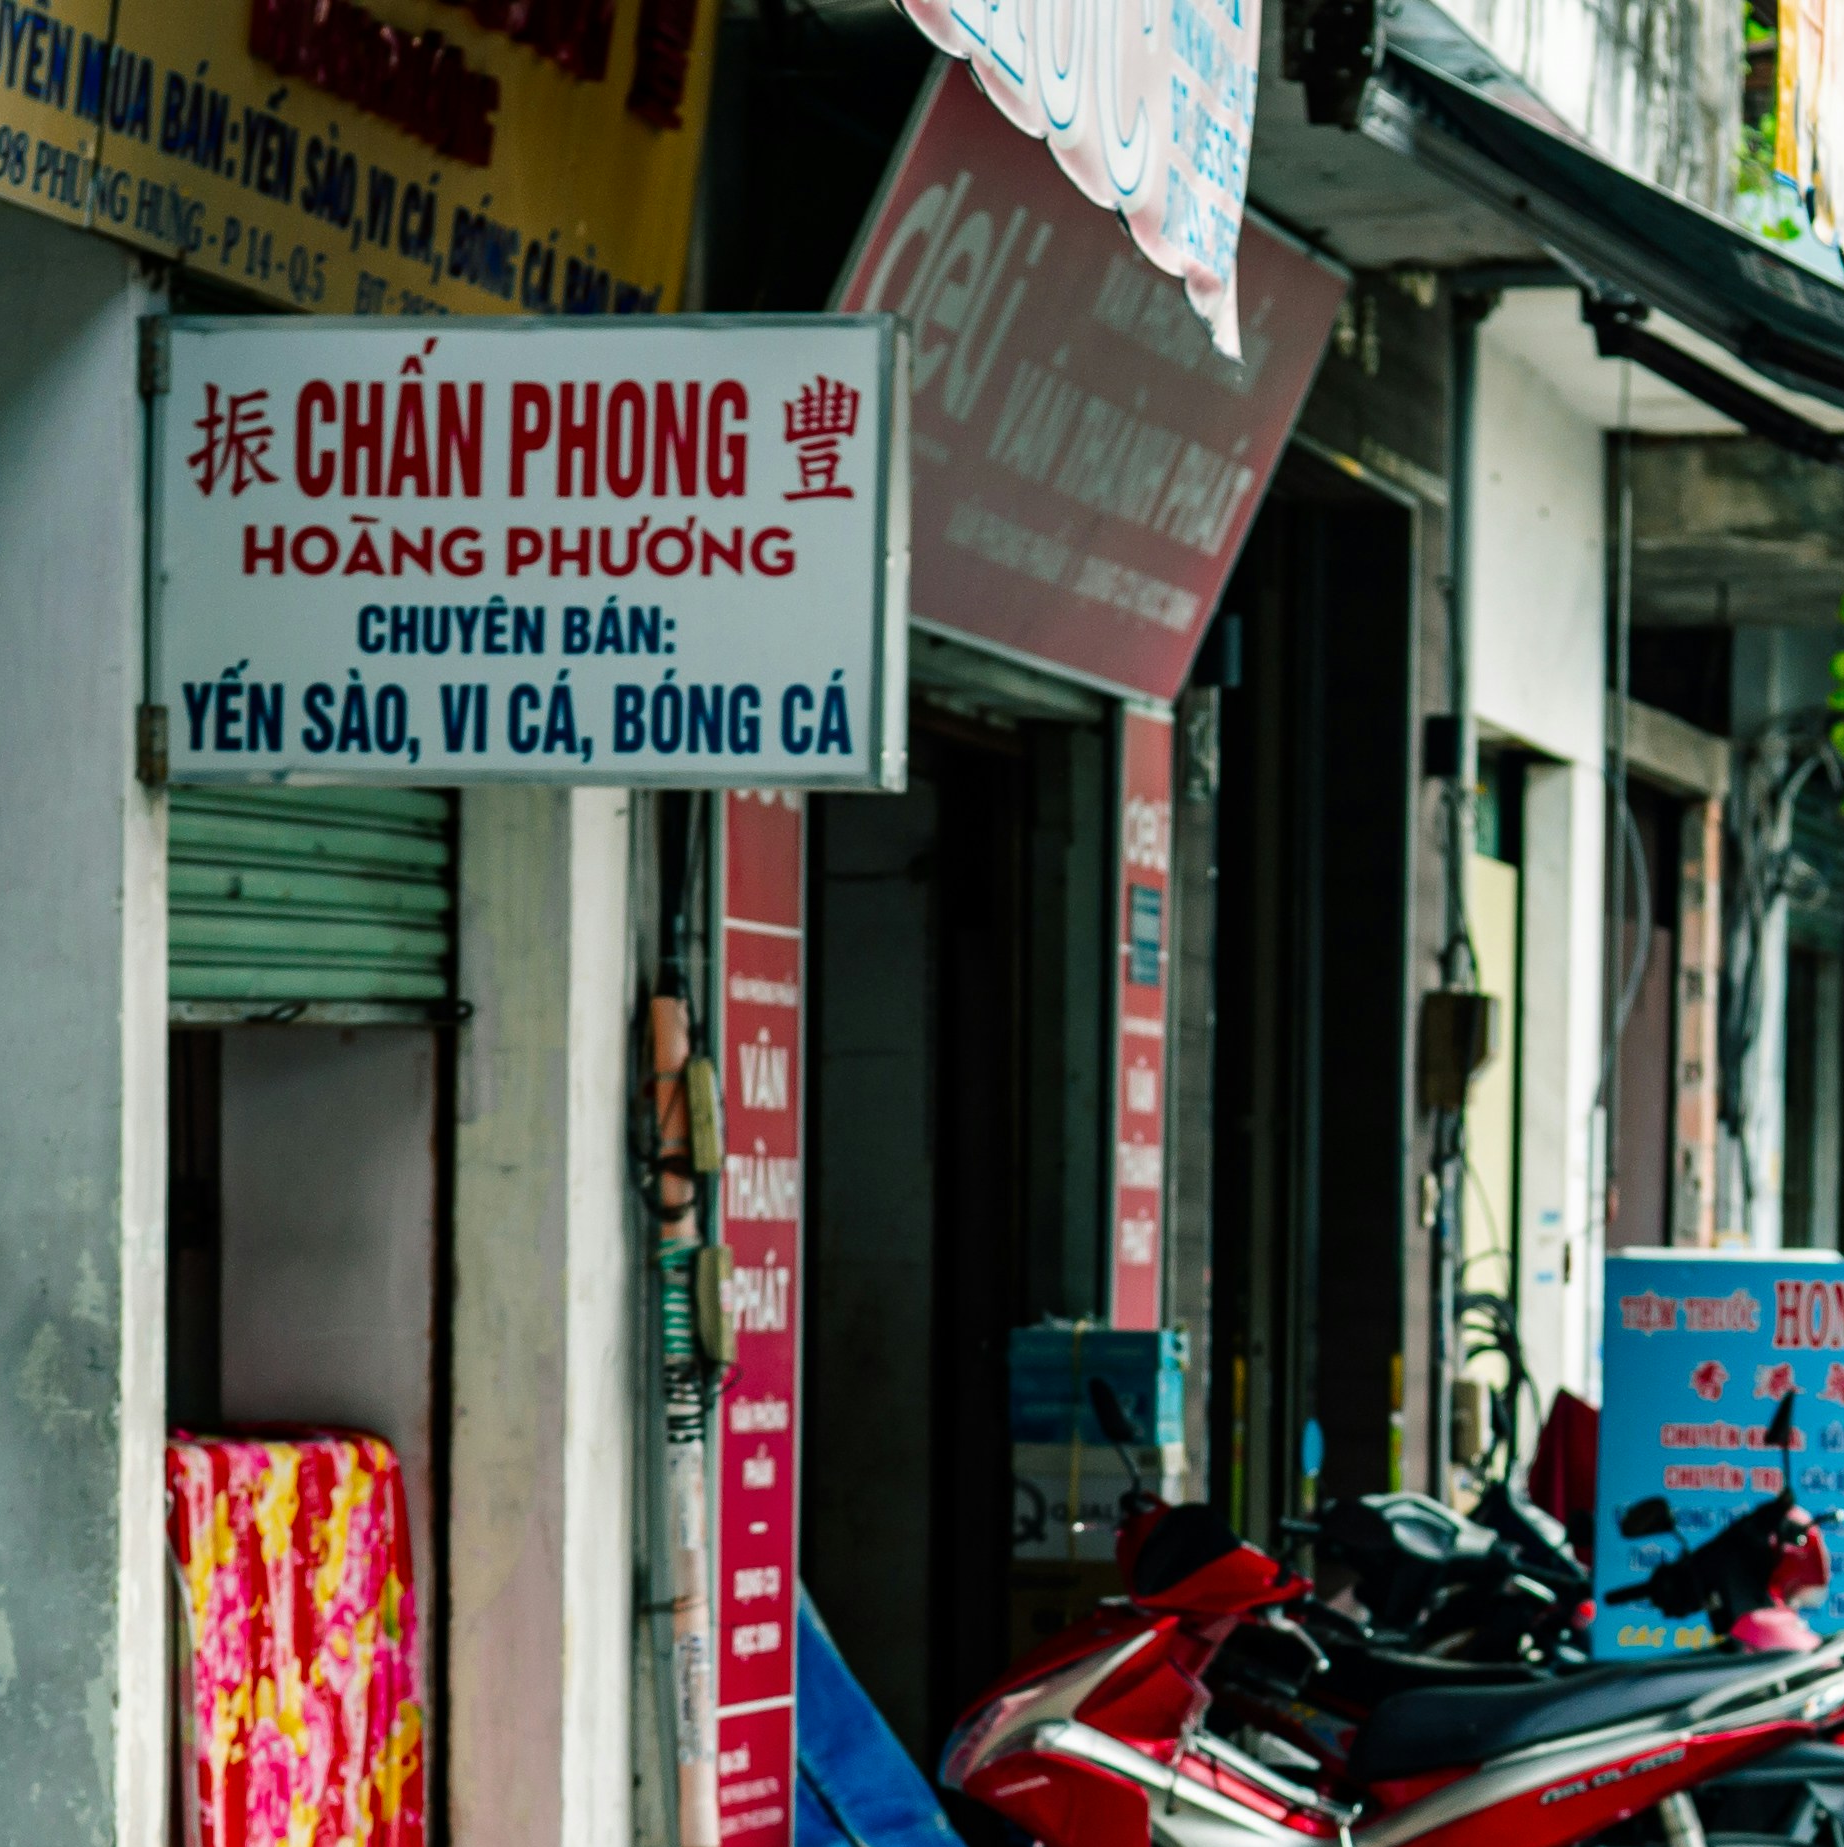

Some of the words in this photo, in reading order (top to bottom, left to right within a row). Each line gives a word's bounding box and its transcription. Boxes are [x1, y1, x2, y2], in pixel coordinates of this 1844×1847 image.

[74, 32, 154, 143] MUA
[864, 168, 1055, 424] deli
[187, 382, 281, 499] 振
[295, 336, 485, 500] CHẤN
[509, 378, 749, 500] PHONG
[242, 514, 487, 578] HOÀNG
[505, 515, 797, 578] PHƯƠNG
[357, 594, 546, 657] CHUYÊN
[561, 595, 677, 657] BÁN:
[182, 659, 285, 756] YẾN
[301, 667, 423, 765] SÀO,
[439, 683, 490, 754] VI
[507, 669, 595, 765] CÁ,
[613, 669, 764, 756] BÓNG
[781, 669, 853, 756] CÁ
